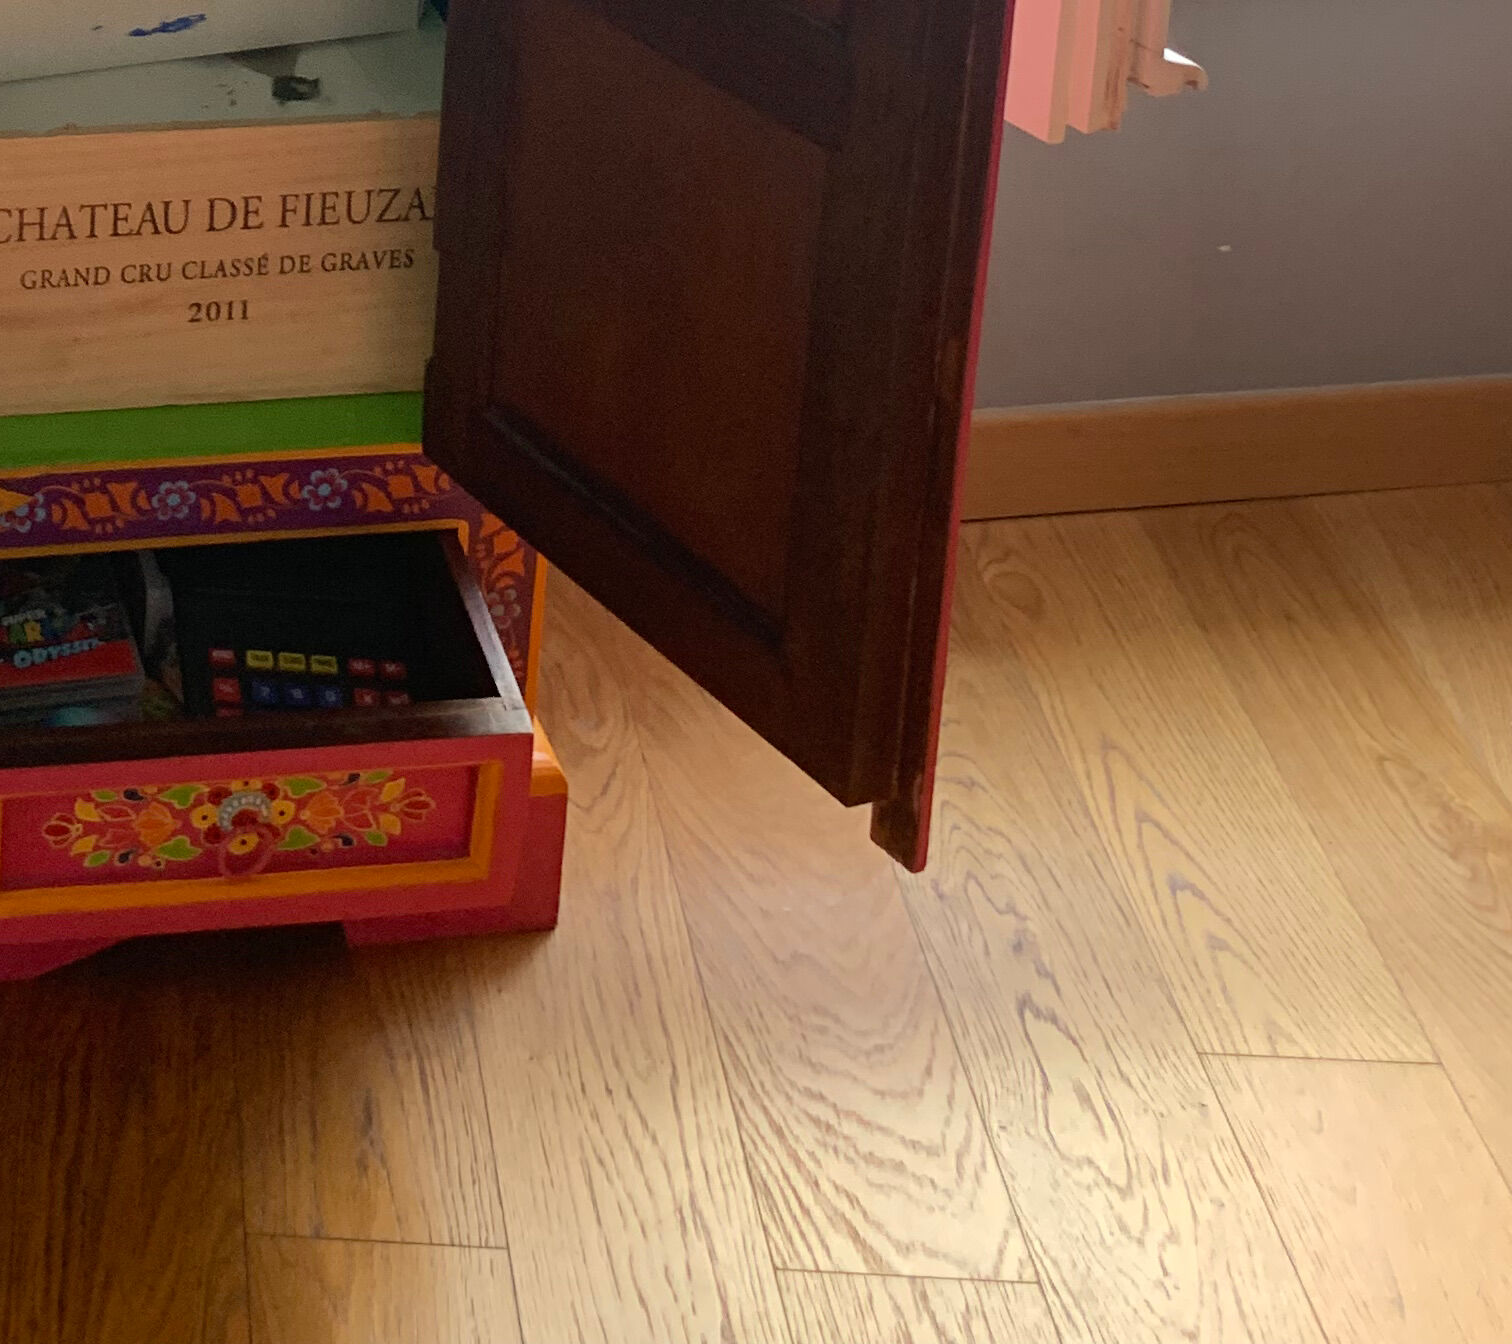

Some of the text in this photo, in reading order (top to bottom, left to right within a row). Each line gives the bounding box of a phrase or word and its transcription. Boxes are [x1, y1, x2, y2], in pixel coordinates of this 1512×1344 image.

[206, 195, 265, 232] DE
[277, 186, 437, 228] FIEUZA
[20, 248, 416, 290] GRAND CRU CLASSÉ DE GRAVES
[187, 299, 249, 324] 2011
